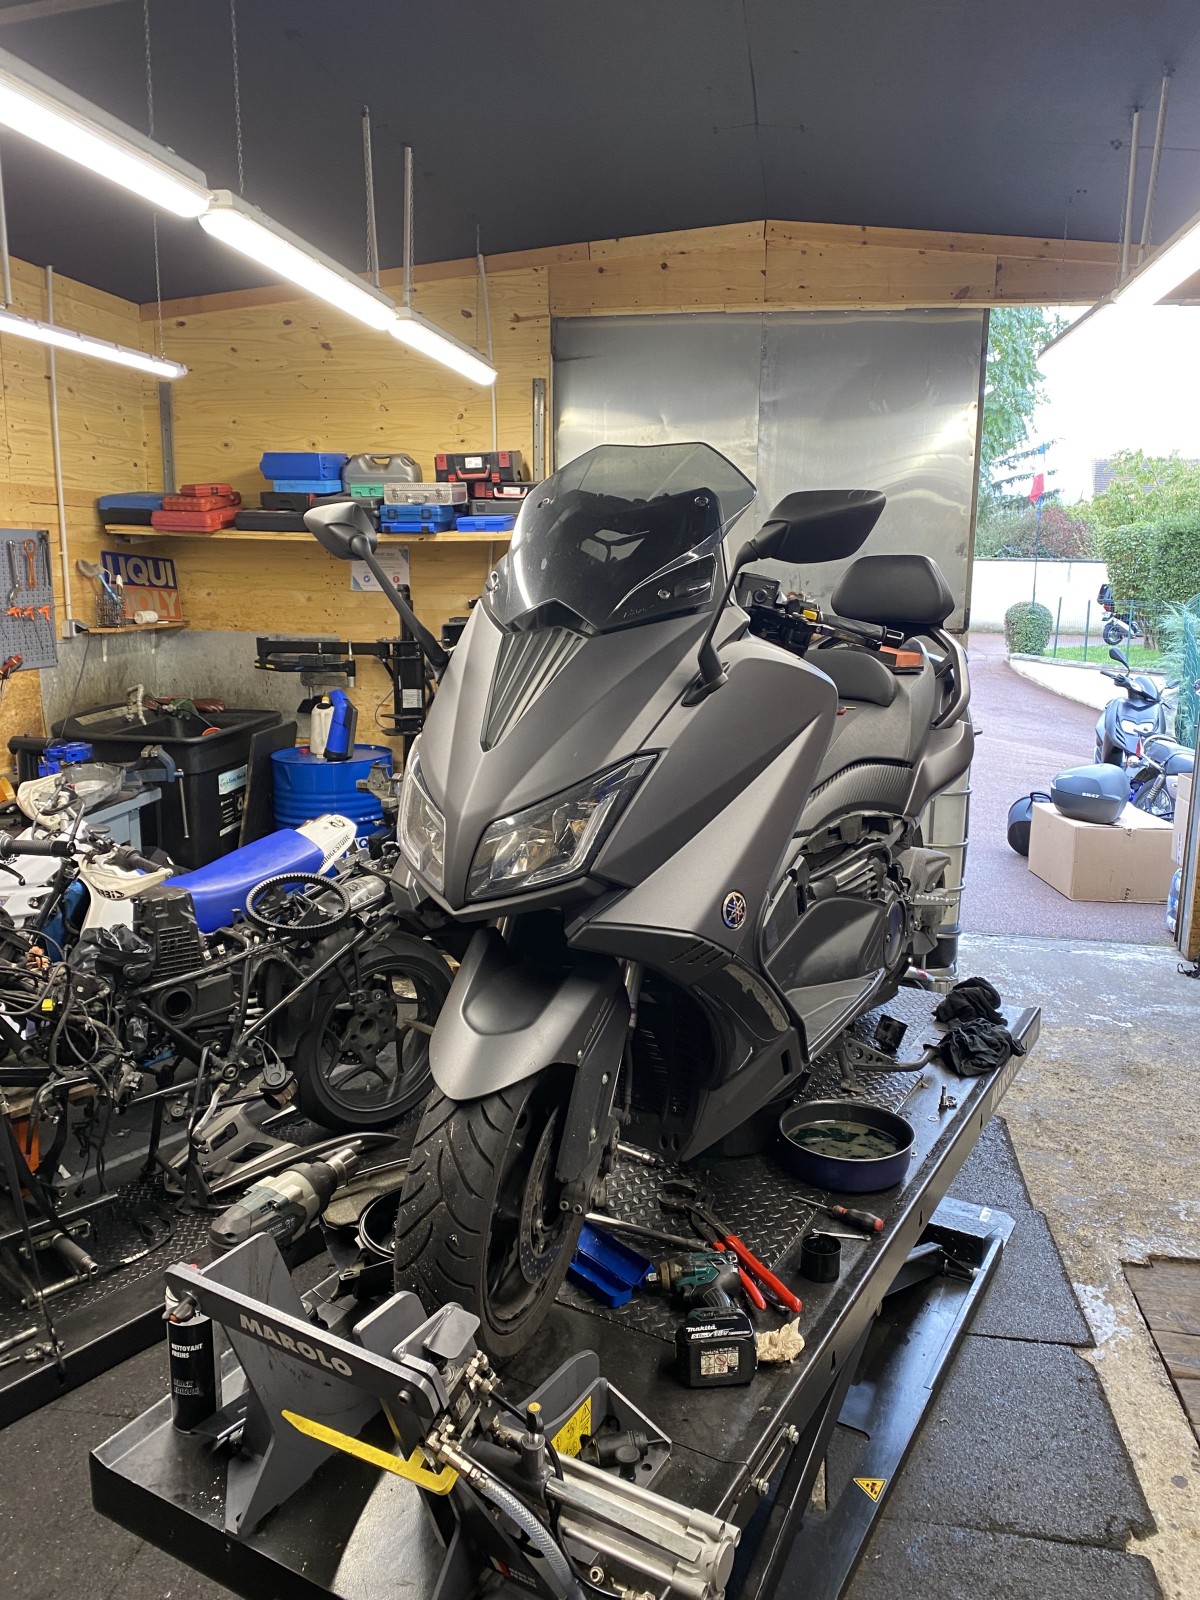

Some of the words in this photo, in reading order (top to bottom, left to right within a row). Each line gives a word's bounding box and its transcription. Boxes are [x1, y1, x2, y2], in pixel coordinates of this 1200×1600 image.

[105, 554, 175, 587] LIQUI
[171, 1342, 203, 1352] NETTOYANT
[171, 1350, 190, 1359] FREINS
[240, 1314, 353, 1377] MAROLO
